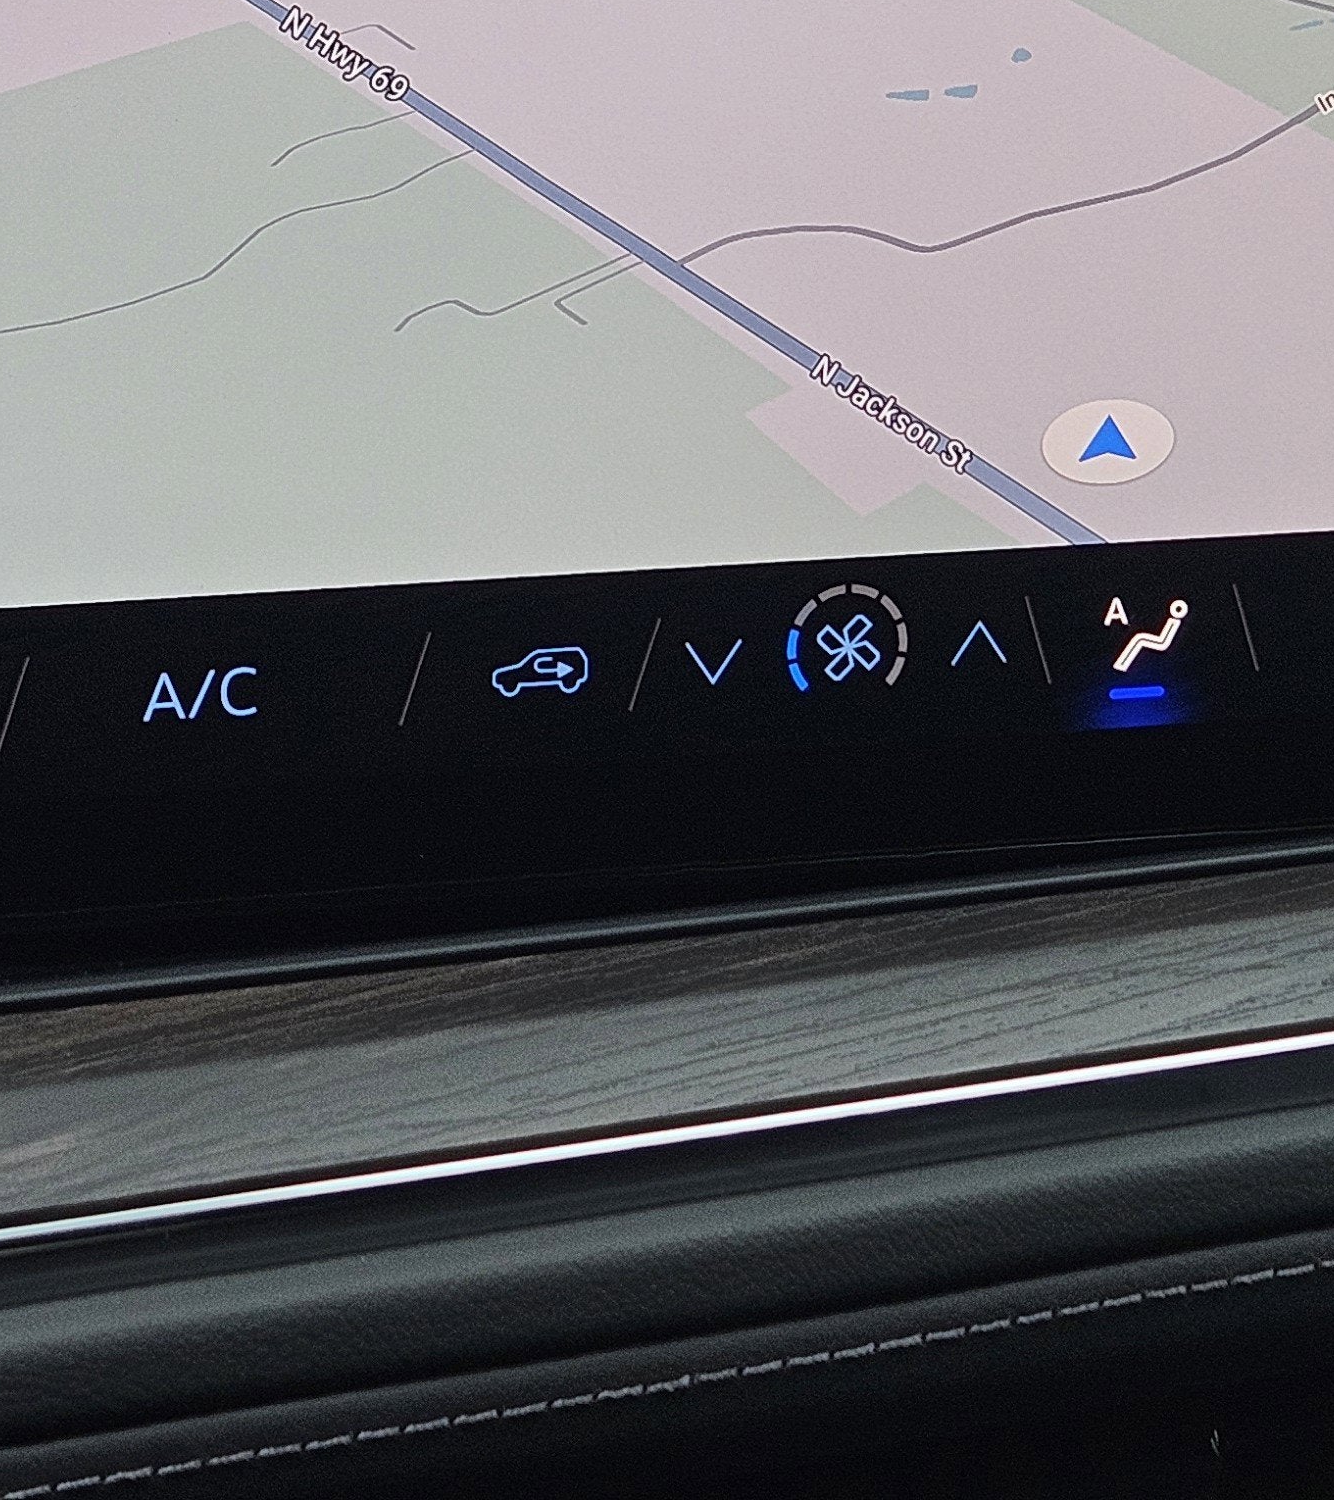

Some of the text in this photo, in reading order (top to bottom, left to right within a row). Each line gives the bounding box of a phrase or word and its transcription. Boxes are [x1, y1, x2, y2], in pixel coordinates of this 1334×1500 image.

[278, 4, 411, 101] N Hwy 69
[809, 352, 974, 475] N Jackson St
[1104, 596, 1129, 626] A
[142, 665, 258, 723] A/C
